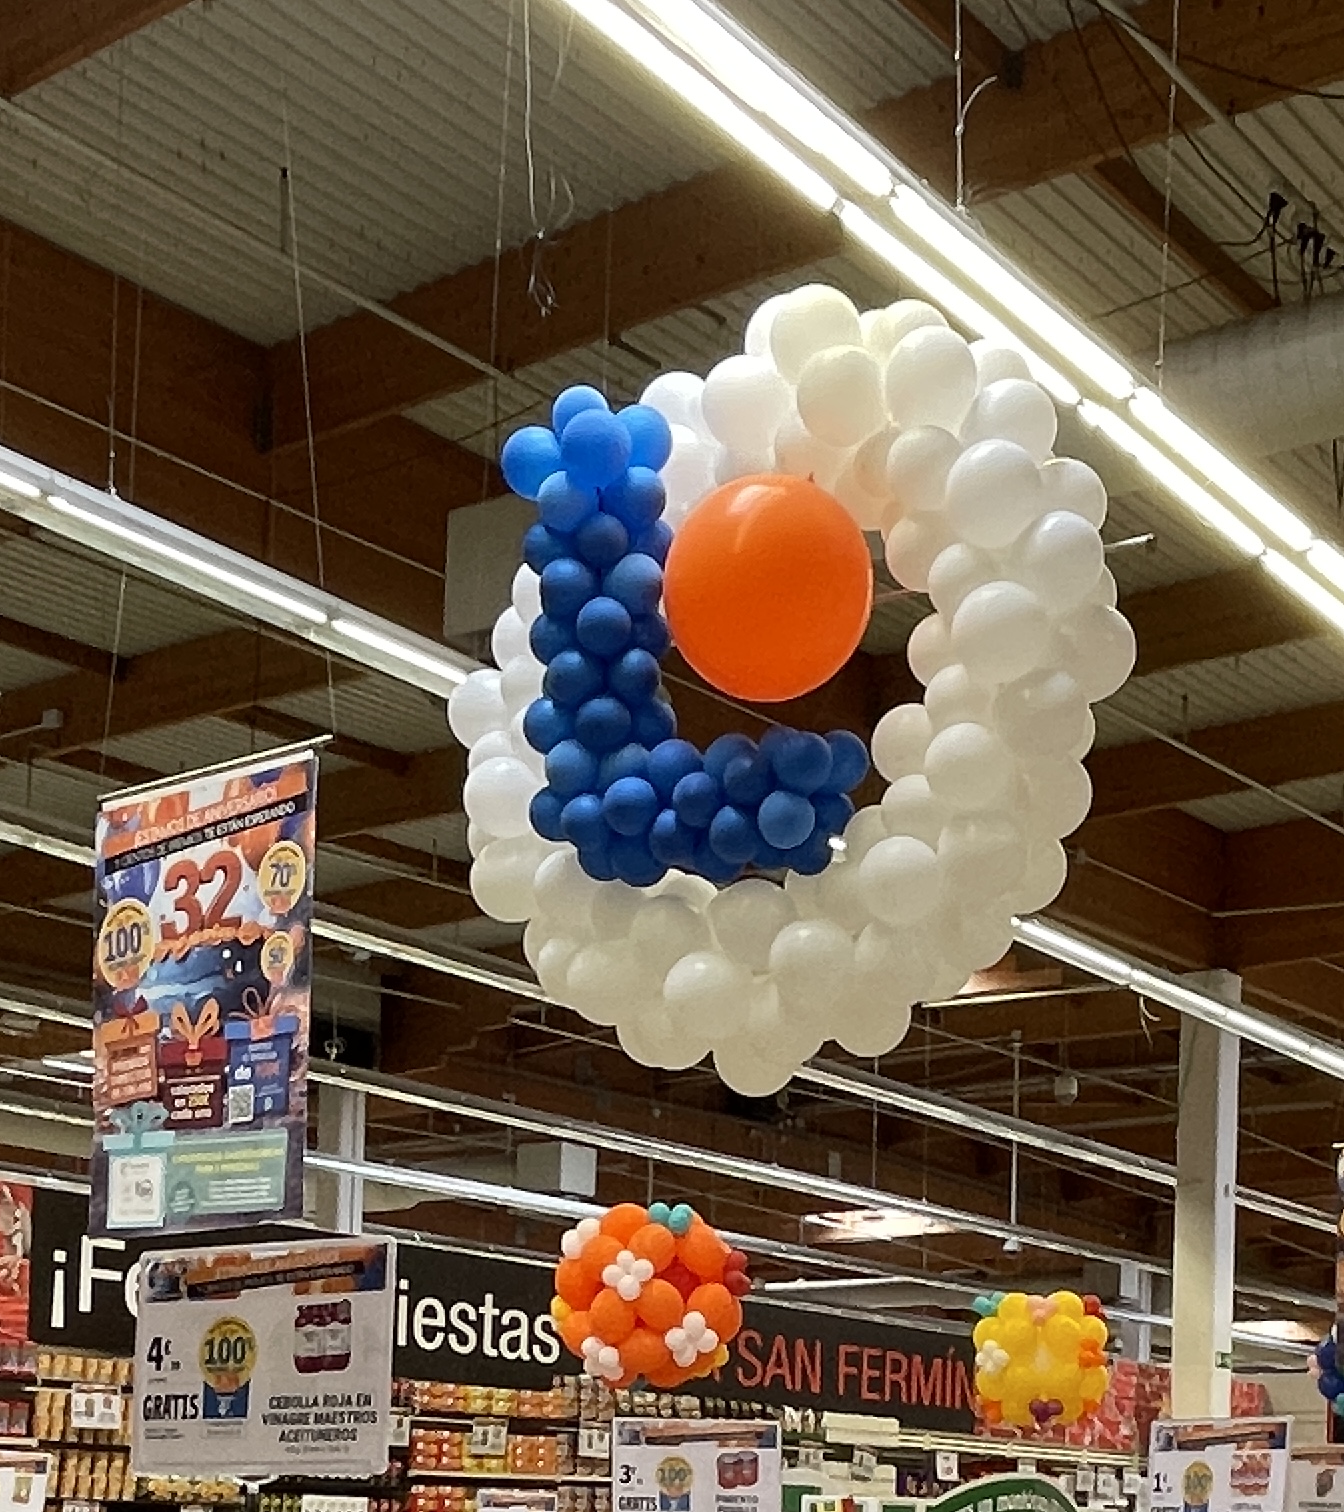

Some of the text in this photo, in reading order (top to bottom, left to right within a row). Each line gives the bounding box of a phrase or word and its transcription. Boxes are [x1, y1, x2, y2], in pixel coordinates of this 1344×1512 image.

[161, 850, 242, 940] 32
[736, 1330, 823, 1395] SAN
[143, 1394, 199, 1421] GRATIS
[269, 1395, 318, 1409] CEBOLLA
[322, 1394, 352, 1408] ROJA
[261, 1410, 378, 1426] VINAGRE MAESTROS
[278, 1428, 358, 1443] ACEITUNEROS
